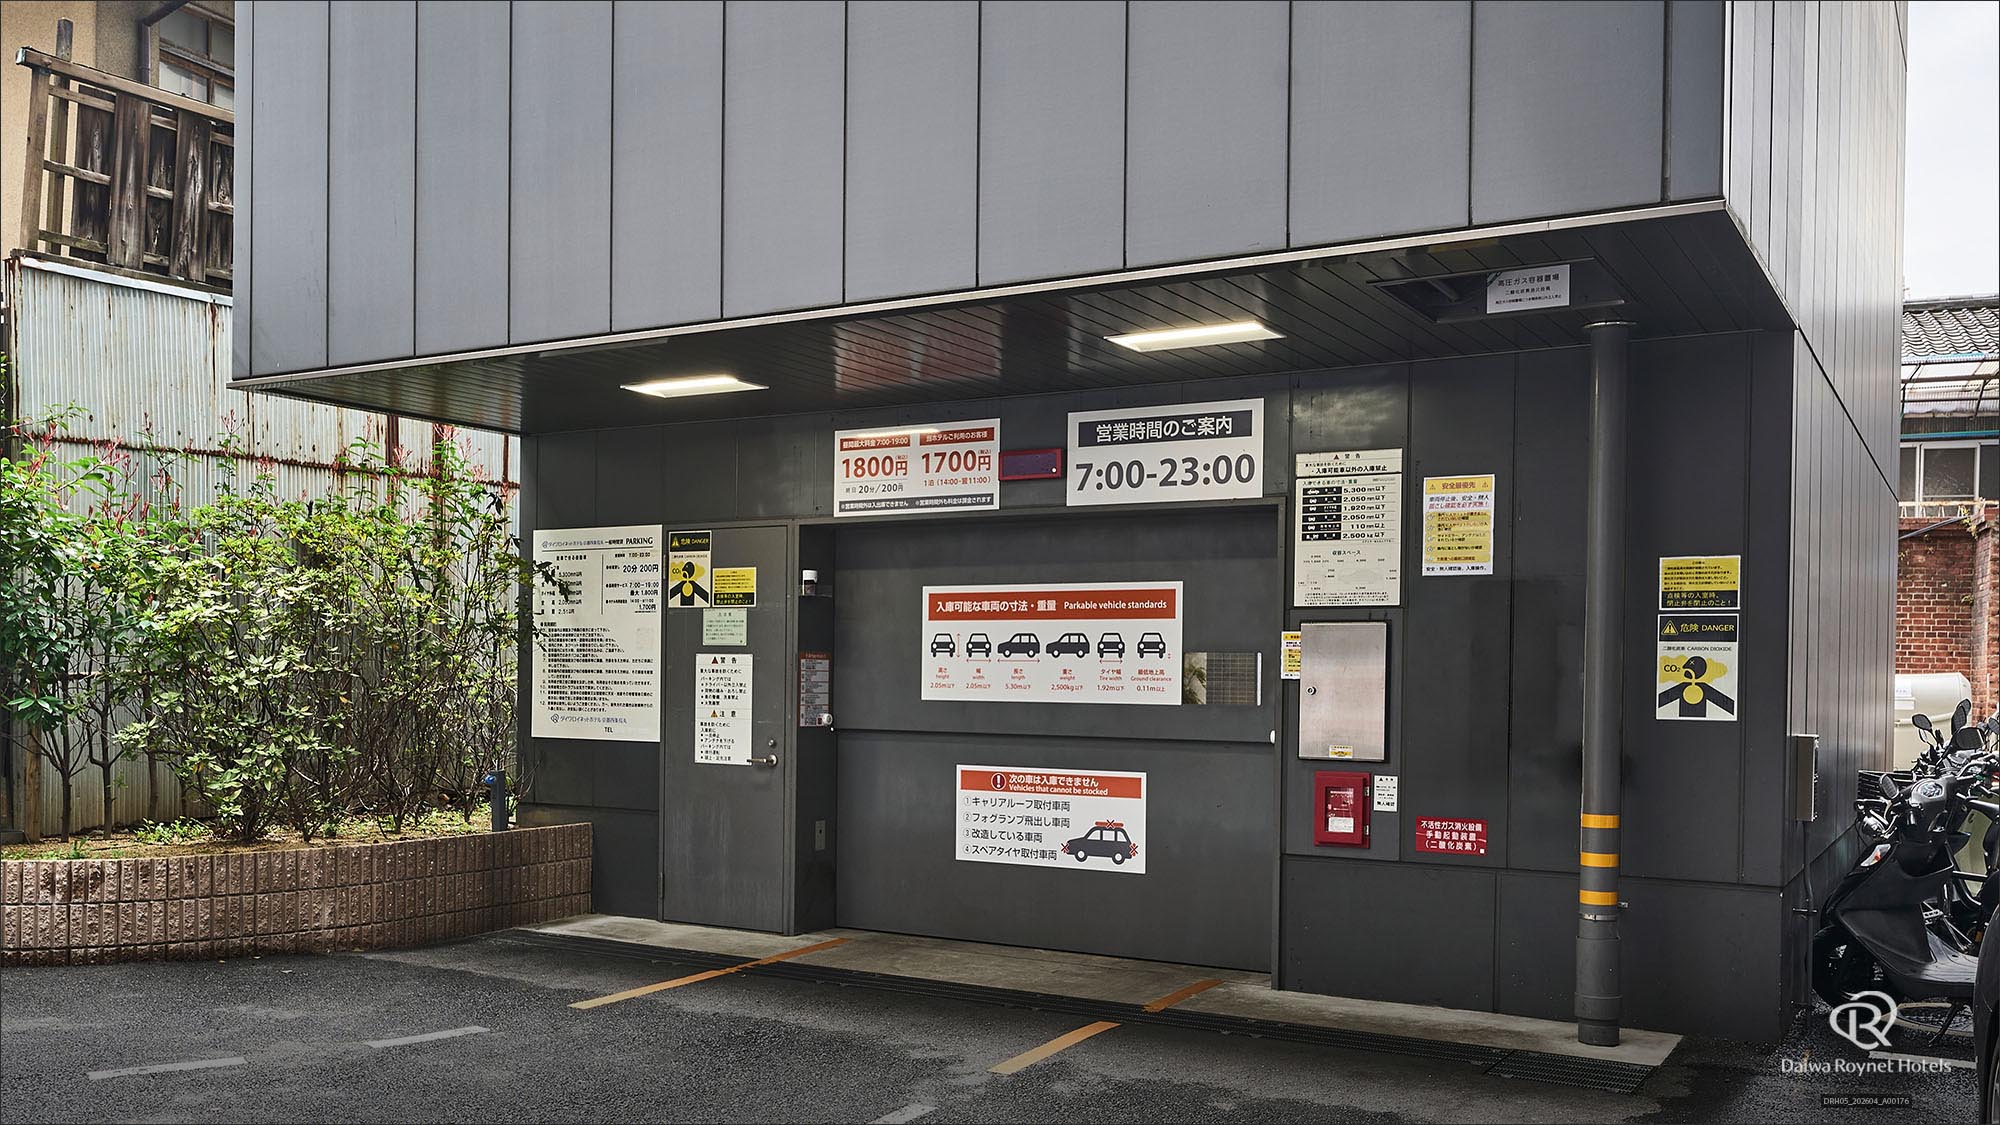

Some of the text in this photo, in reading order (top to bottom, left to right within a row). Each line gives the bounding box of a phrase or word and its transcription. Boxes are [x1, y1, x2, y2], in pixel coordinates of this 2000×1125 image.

[1096, 416, 1233, 443] 営業時間のご案内
[841, 455, 909, 478] 1800円
[921, 450, 992, 475] 1700円
[1075, 453, 1256, 491] 7:00-23:00
[625, 537, 654, 546] PARKING
[936, 600, 1167, 612] 入庫可能な車両の寸法・重量 Parkable vehicle standards
[1680, 623, 1735, 632] 危険 DANGER
[1008, 773, 1099, 787] 次の車は入庫できません
[1049, 787, 1071, 795] cannot
[1071, 787, 1081, 795] be
[1082, 787, 1108, 796] stocked
[1421, 820, 1482, 832] 不活性ガス消火設備
